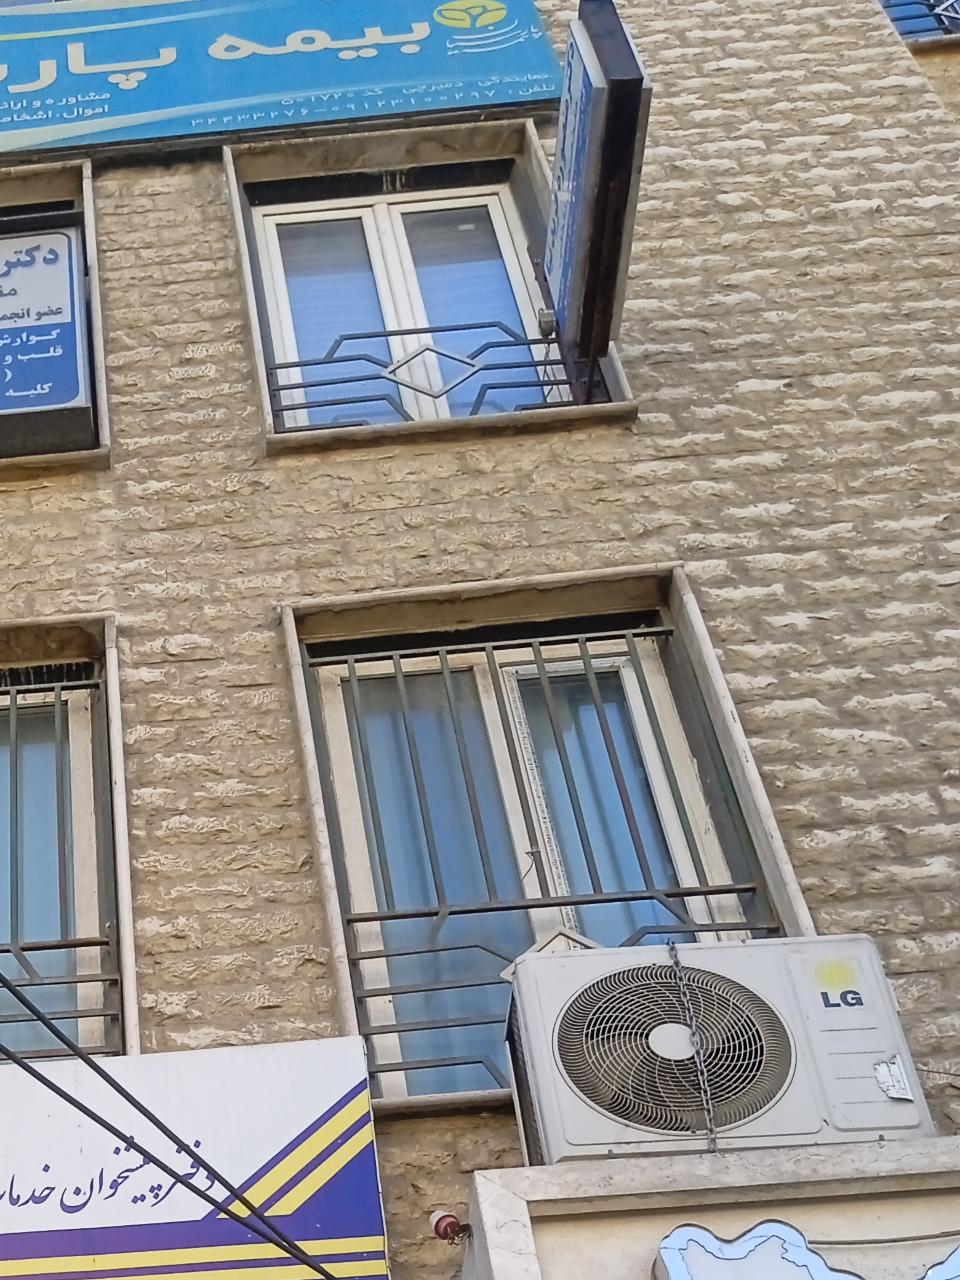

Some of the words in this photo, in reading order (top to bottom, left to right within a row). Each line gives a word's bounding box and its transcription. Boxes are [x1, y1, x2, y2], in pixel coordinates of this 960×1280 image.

[207, 21, 431, 60] بیمه
[32, 99, 42, 108] و
[44, 91, 111, 106] مشاوره
[34, 305, 63, 321] عضو
[2, 355, 13, 365] و
[17, 345, 63, 362] قلب
[5, 382, 53, 398] کلیه
[820, 990, 865, 1010] LG
